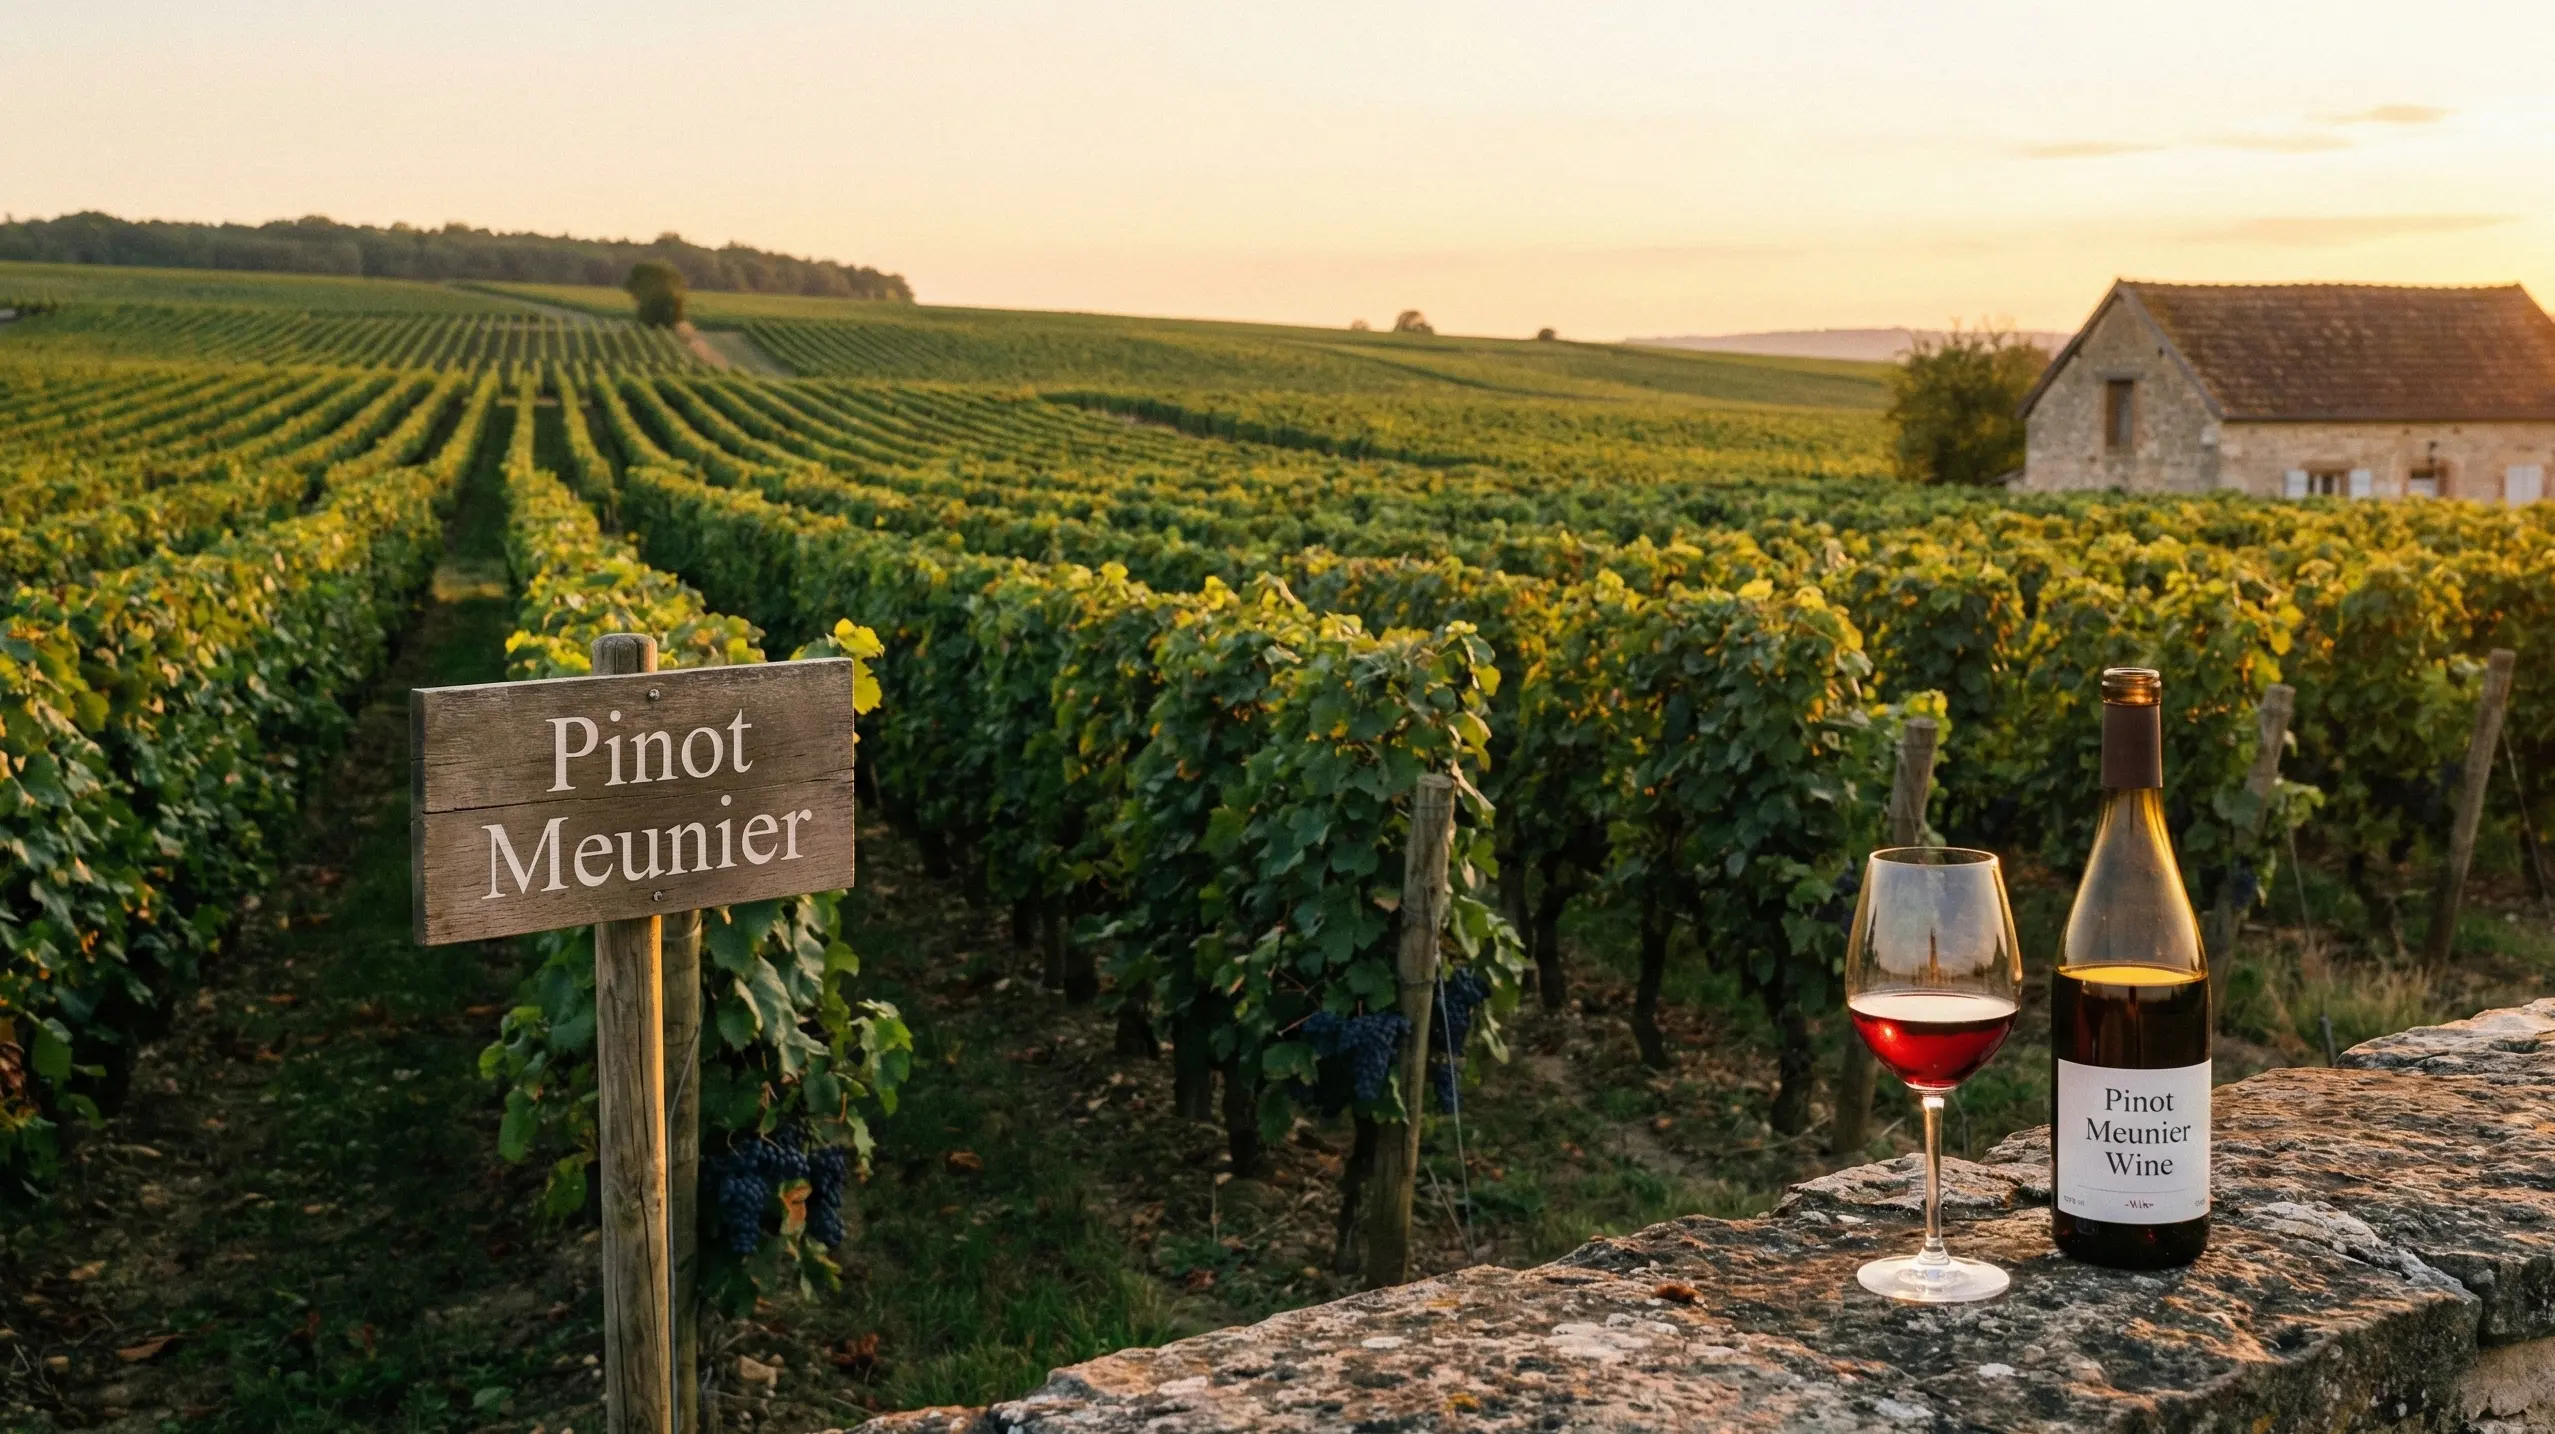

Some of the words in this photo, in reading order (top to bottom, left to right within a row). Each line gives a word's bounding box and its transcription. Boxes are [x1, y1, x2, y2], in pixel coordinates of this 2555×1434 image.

[545, 708, 753, 792] Pinot
[481, 795, 813, 900] Meunier
[2105, 1088, 2174, 1112] Pinot
[2086, 1118, 2191, 1144] Meunier
[2106, 1152, 2173, 1176] Wine
